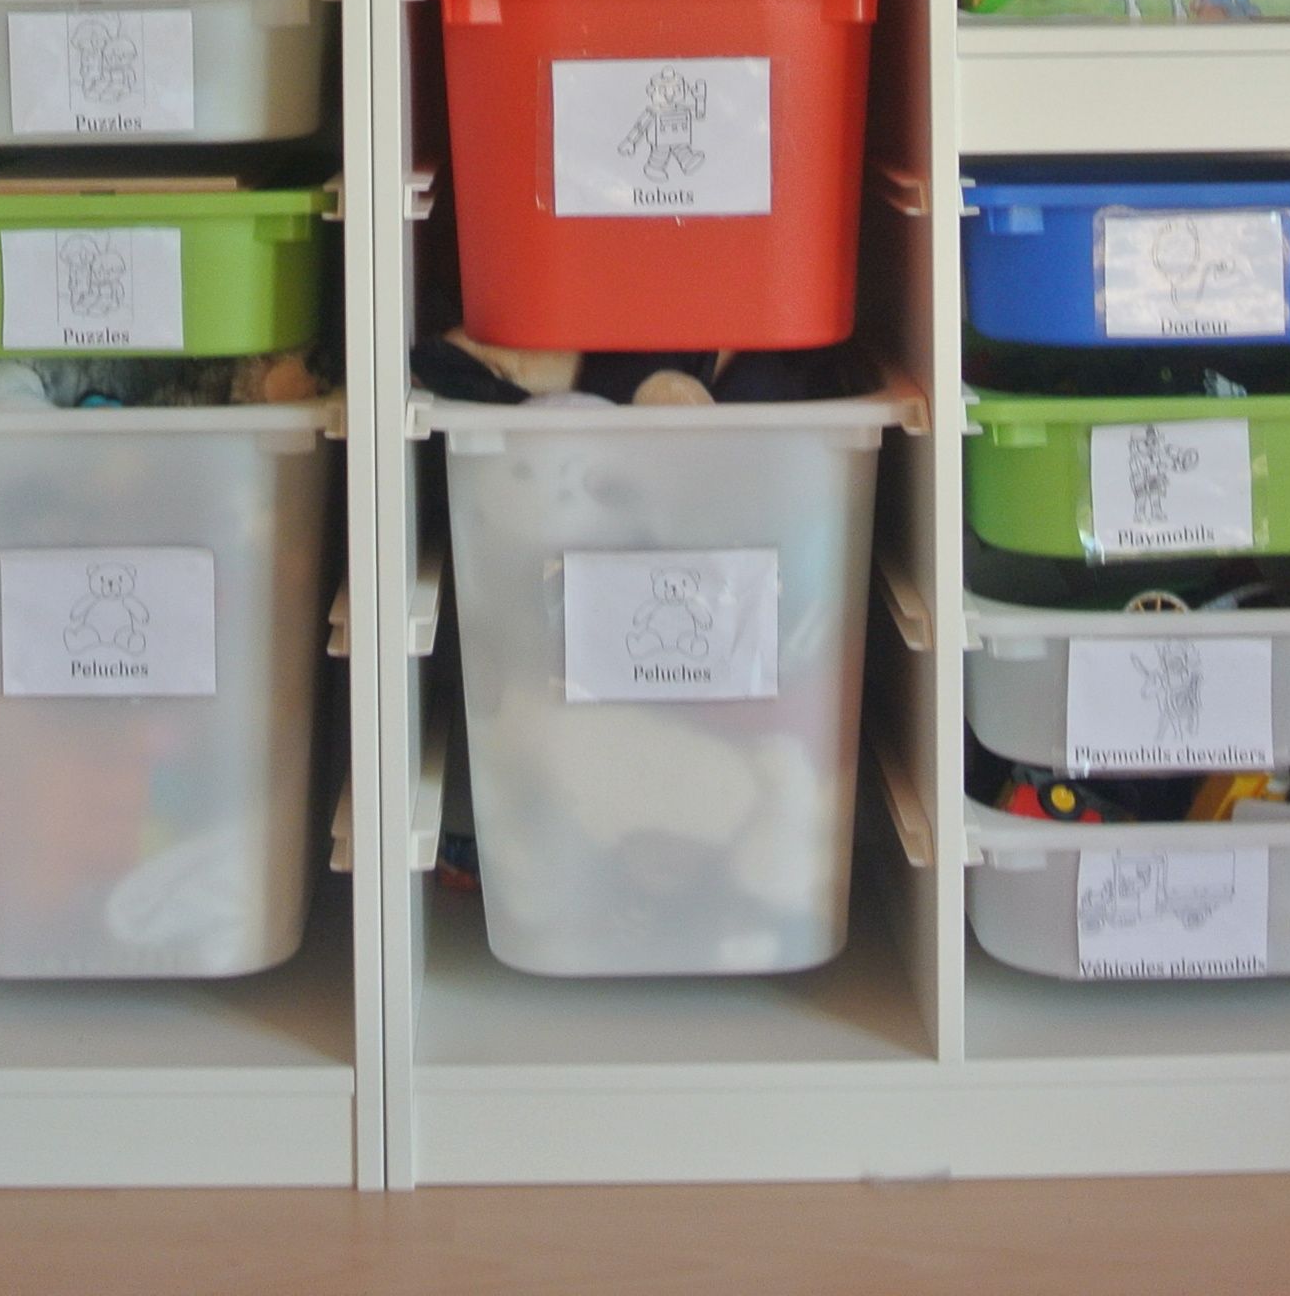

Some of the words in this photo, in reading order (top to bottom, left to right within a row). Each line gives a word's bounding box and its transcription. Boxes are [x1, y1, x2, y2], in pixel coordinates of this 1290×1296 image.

[75, 112, 142, 132] Puzzles
[632, 186, 695, 206] Robots
[62, 325, 131, 345] Puzzles
[1158, 317, 1230, 337] Docteur
[1117, 523, 1215, 548] Playmobils
[70, 658, 148, 678] Peluches
[633, 663, 711, 683] Peluches
[1074, 744, 1171, 769] Playmobils
[1175, 744, 1266, 765] chevaliers
[1080, 957, 1164, 979] Véhicules
[1169, 955, 1266, 980] playmobils
